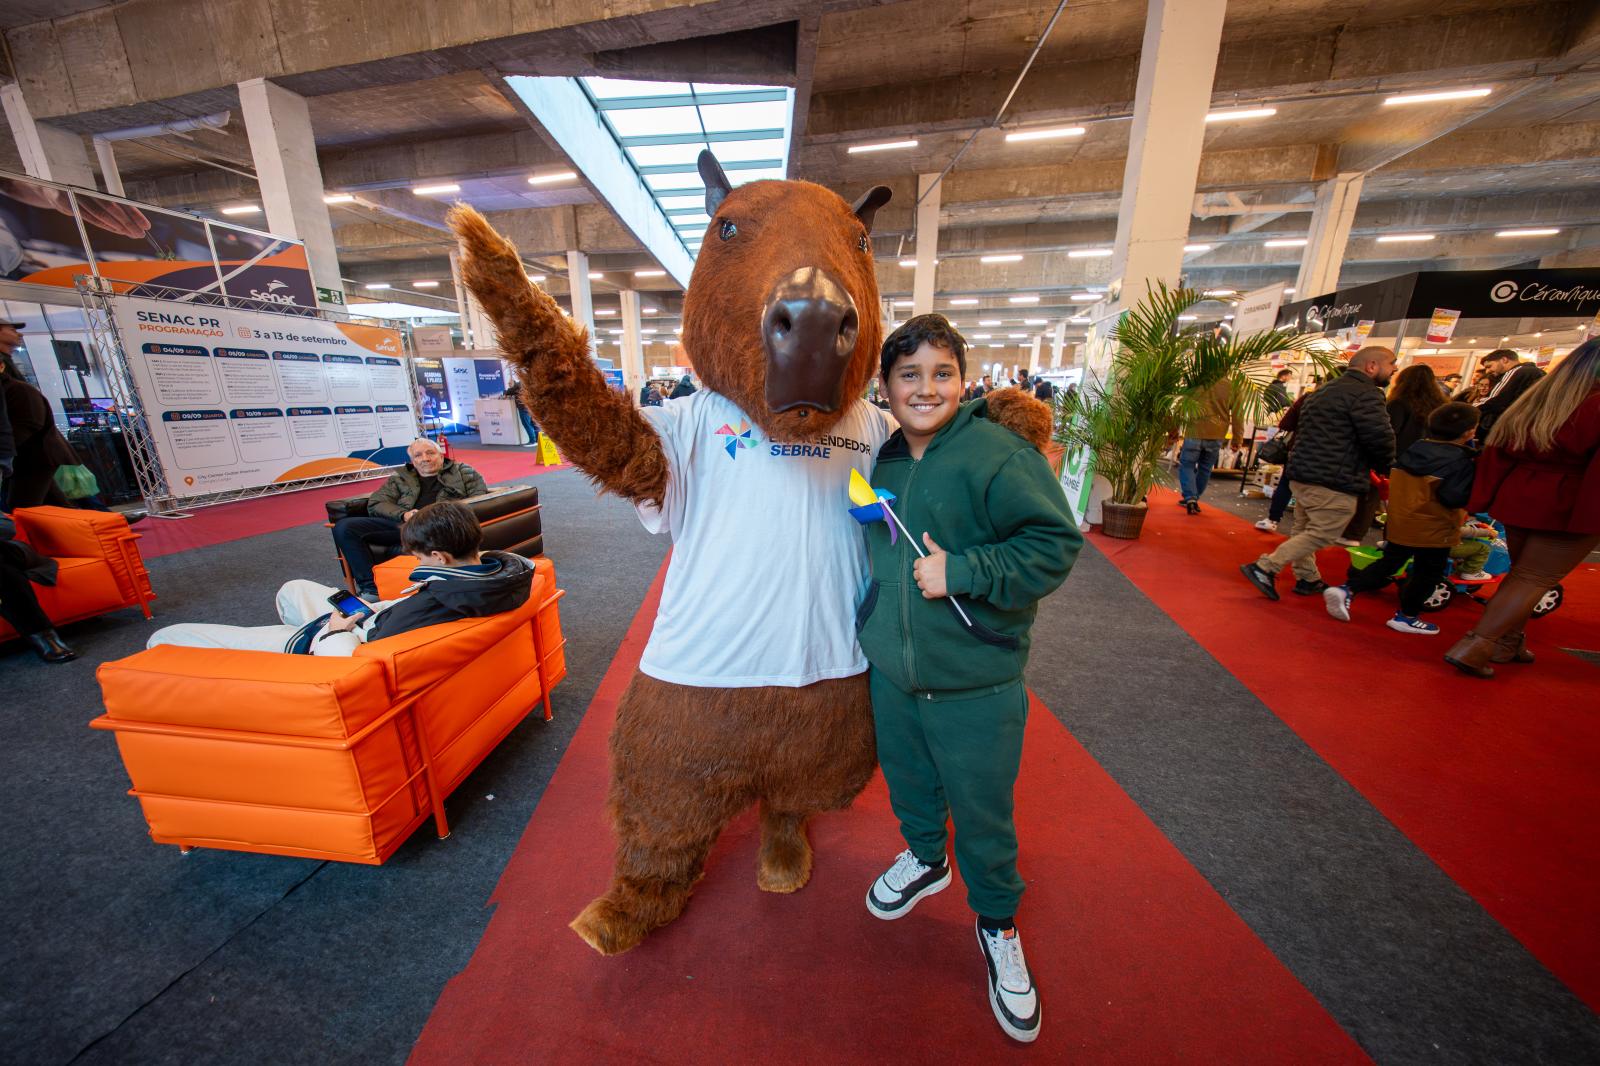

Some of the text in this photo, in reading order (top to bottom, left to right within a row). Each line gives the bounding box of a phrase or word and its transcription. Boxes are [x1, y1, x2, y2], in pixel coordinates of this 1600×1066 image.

[137, 311, 221, 329] SENAC PR
[138, 324, 224, 337] PROGRAMAÇÃO
[254, 330, 261, 339] 3
[272, 331, 284, 340] 13
[286, 333, 299, 342] de
[301, 335, 347, 346] setembro
[769, 434, 871, 455] ENDEDOR
[770, 444, 831, 458] SEBRAE
